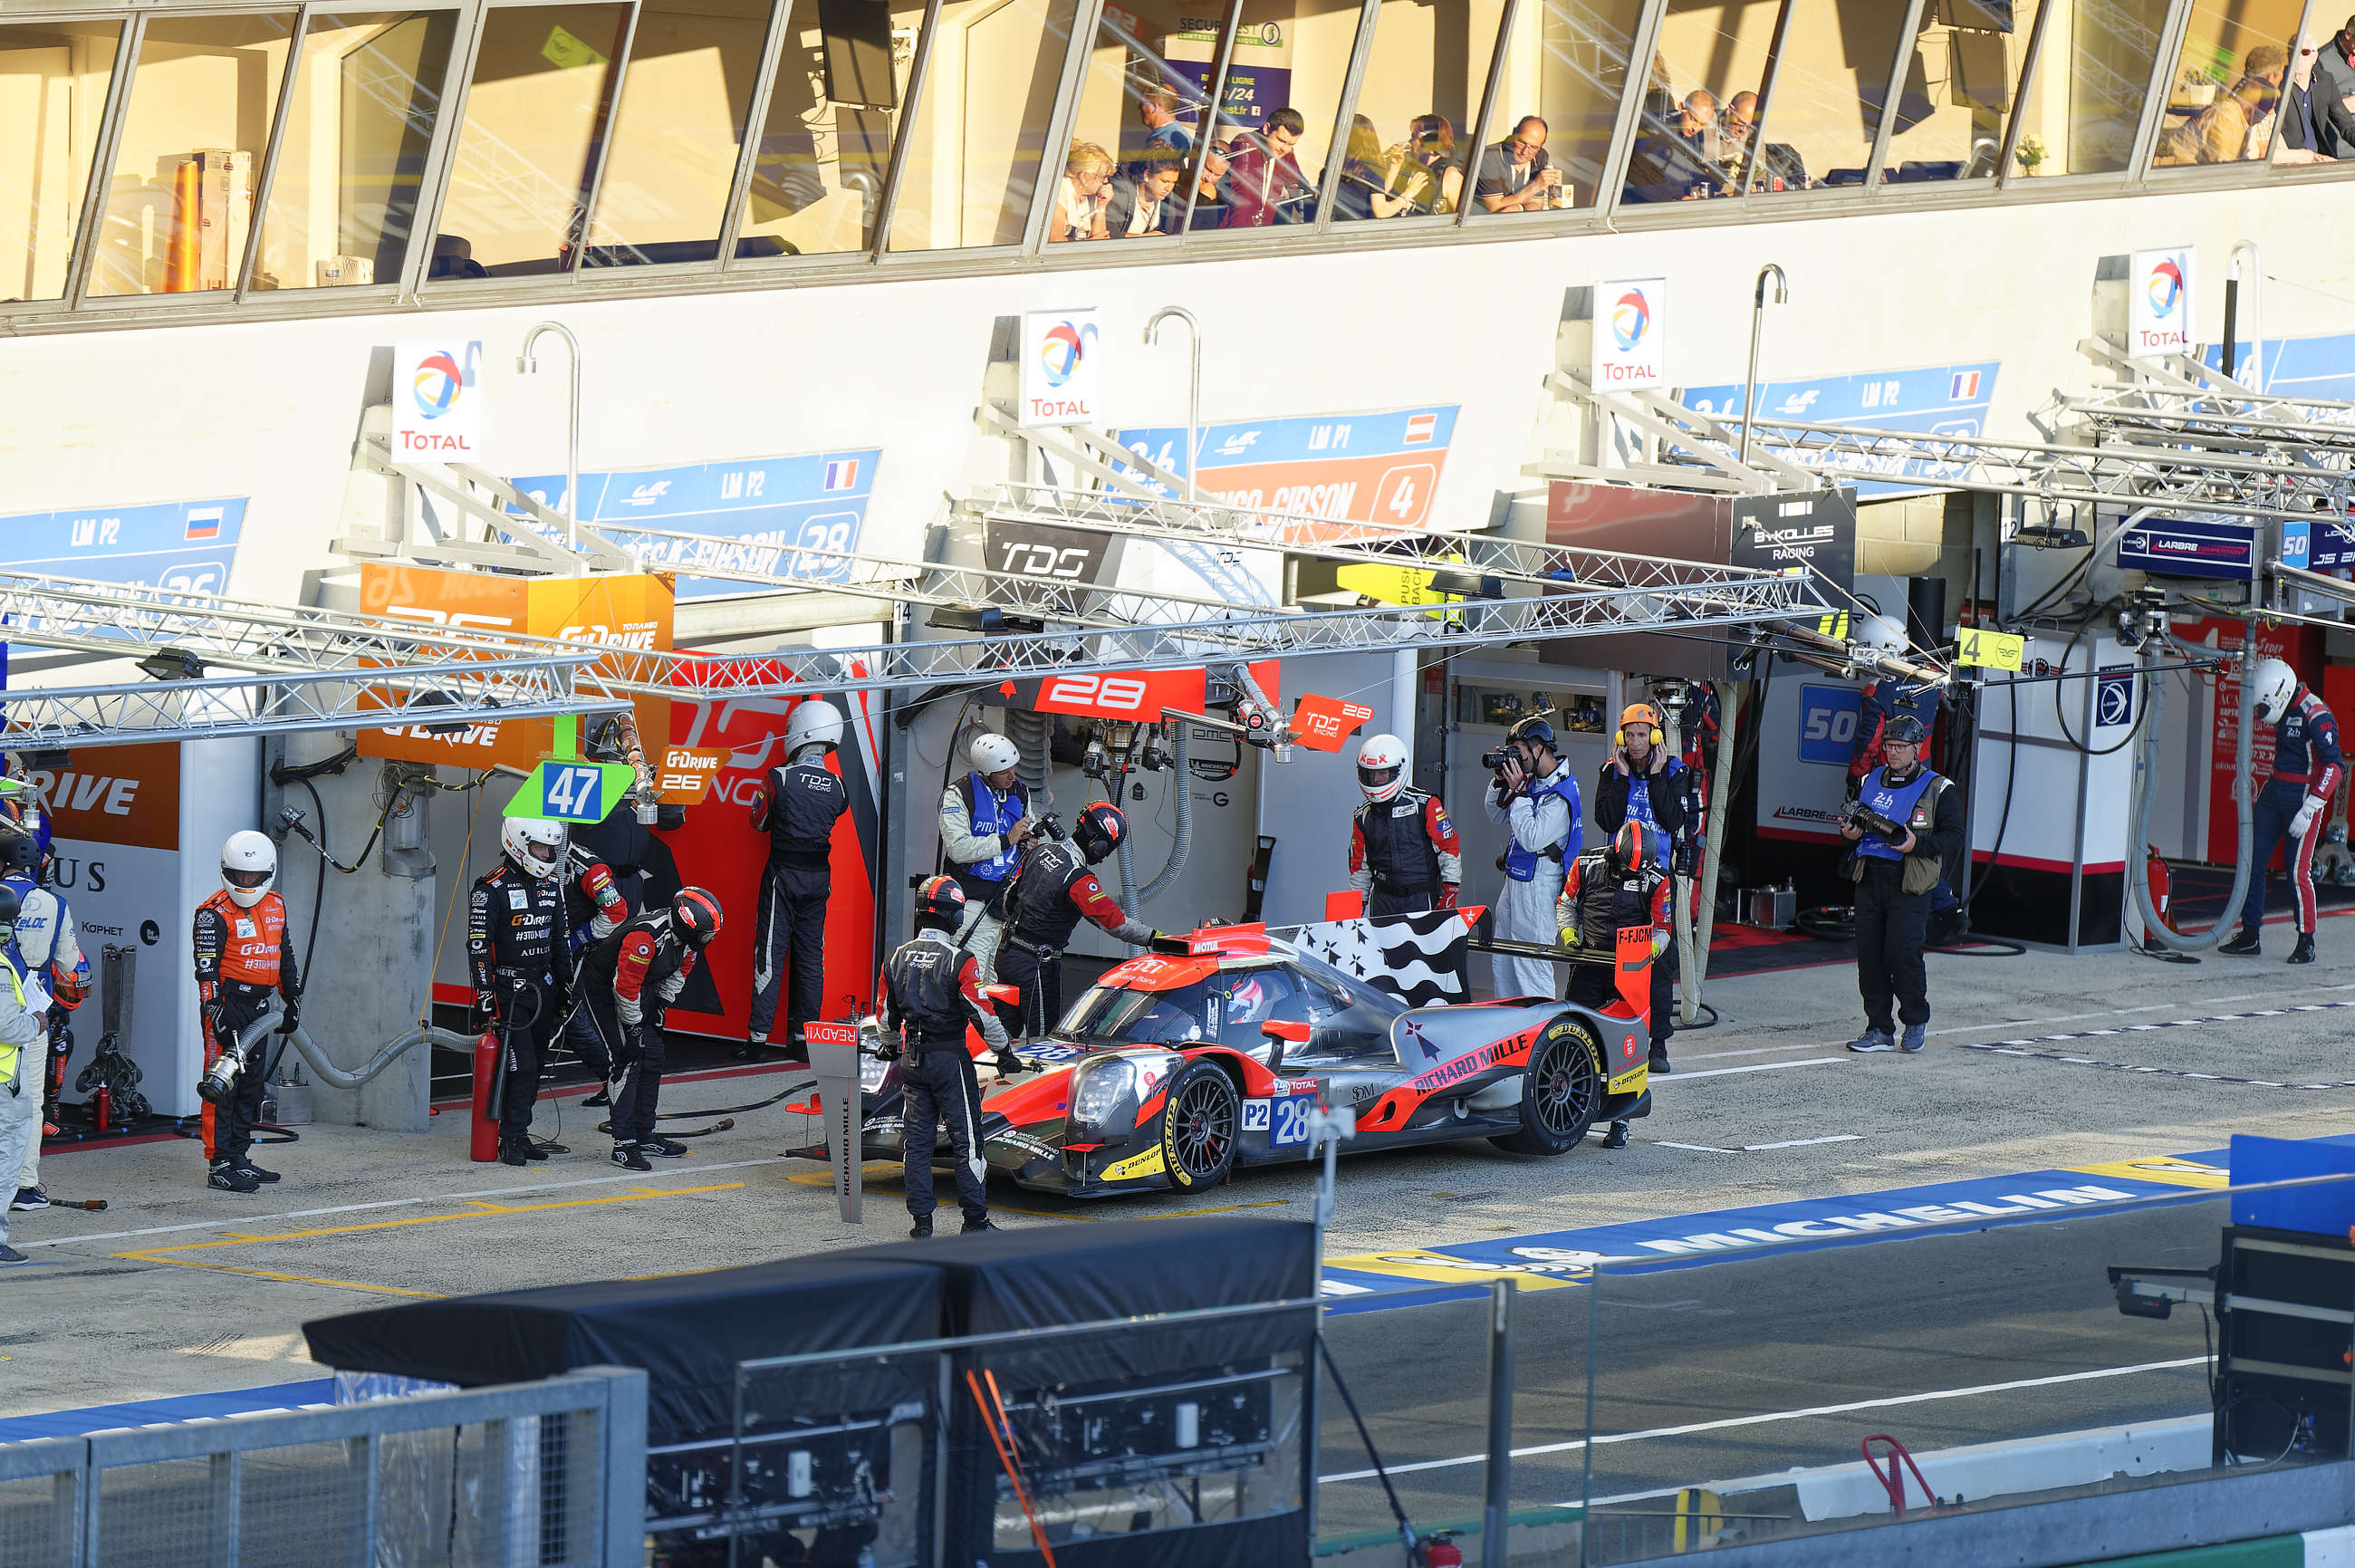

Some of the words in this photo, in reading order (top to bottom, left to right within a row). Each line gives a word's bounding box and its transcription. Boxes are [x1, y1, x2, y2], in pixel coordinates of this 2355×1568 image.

[2140, 330, 2189, 347] TOTAL
[1603, 363, 1657, 380] TOTAL
[1031, 399, 1090, 417] TOTAL
[400, 430, 471, 450] TOTAL
[1307, 425, 1331, 450] LM
[1331, 424, 1352, 449] P1
[720, 472, 742, 499] LM
[745, 469, 766, 496] P2
[1389, 476, 1416, 519] 4
[71, 518, 97, 547] LM
[98, 517, 121, 545] P2
[1773, 546, 1815, 560] RACING
[2158, 540, 2199, 553] LARBRE
[2283, 535, 2308, 556] 50
[1002, 541, 1090, 578] TDS
[2313, 553, 2337, 565] JS
[894, 601, 911, 621] 14
[1963, 632, 1981, 663] 4
[1048, 675, 1149, 712] 28
[1341, 703, 1372, 720] 28
[1307, 711, 1341, 732] TDS
[1802, 707, 1858, 745] 50
[1313, 726, 1338, 738] RACING
[661, 774, 703, 791] 26
[799, 772, 832, 787] TDS
[807, 783, 832, 793] RACING
[546, 766, 600, 815] 47
[1780, 805, 1828, 821] LARBRE
[1039, 847, 1064, 870] TDS
[1619, 928, 1653, 945] F-FJCM
[905, 949, 941, 964] TDS
[1193, 941, 1219, 954] MOTUL
[908, 960, 935, 969] RACING
[1136, 976, 1158, 986] Bank
[804, 1024, 857, 1043] READY!!
[1414, 1053, 1479, 1097] RICHARD
[1477, 1033, 1529, 1067] MILLE
[1290, 1080, 1317, 1090] TOTAL
[1620, 1069, 1646, 1085] DUNLOP
[1245, 1103, 1268, 1127] P2
[1275, 1098, 1311, 1145] 28
[994, 1136, 1030, 1150] RICHARD
[1031, 1146, 1055, 1161] MILLE
[1127, 1148, 1162, 1170] DUNLOP
[1634, 1183, 2139, 1256] MICHELIN
